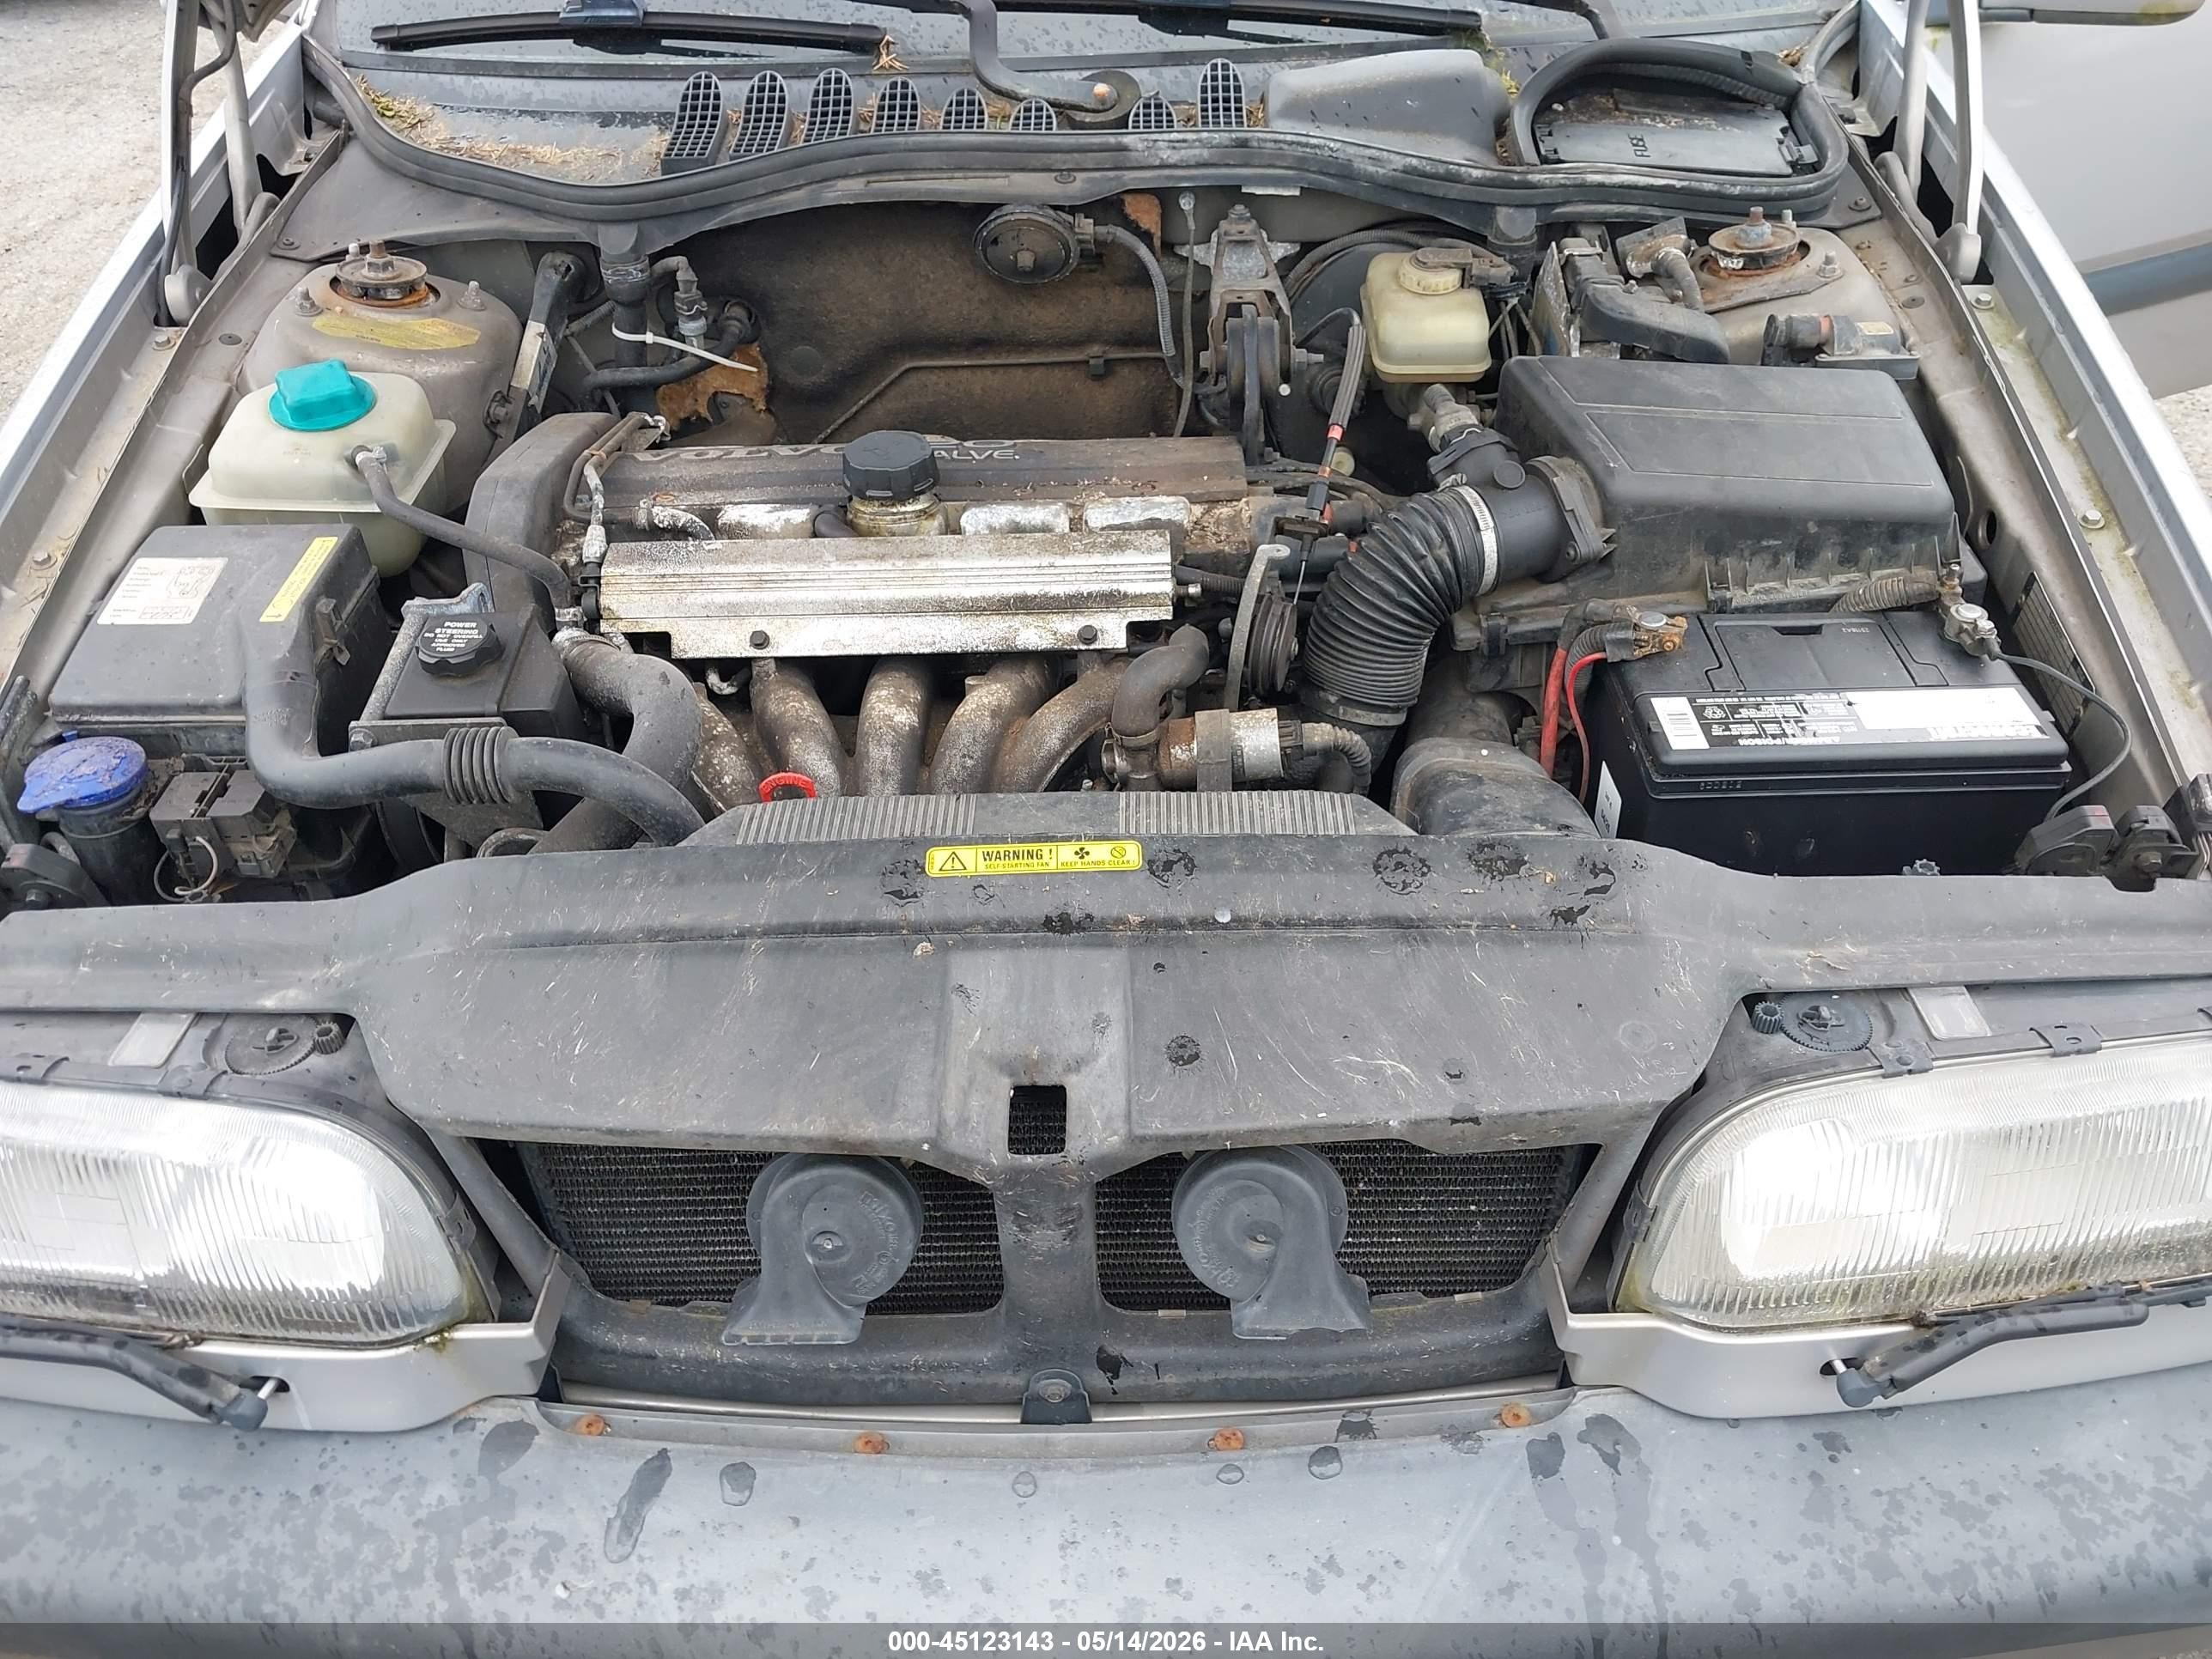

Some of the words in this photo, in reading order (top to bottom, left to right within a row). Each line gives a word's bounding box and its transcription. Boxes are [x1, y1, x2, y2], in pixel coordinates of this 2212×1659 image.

[1627, 133, 1650, 158] FUSE
[933, 450, 1015, 460] ALVE
[762, 775, 808, 793] ENGINE
[982, 848, 1043, 862] WARNING
